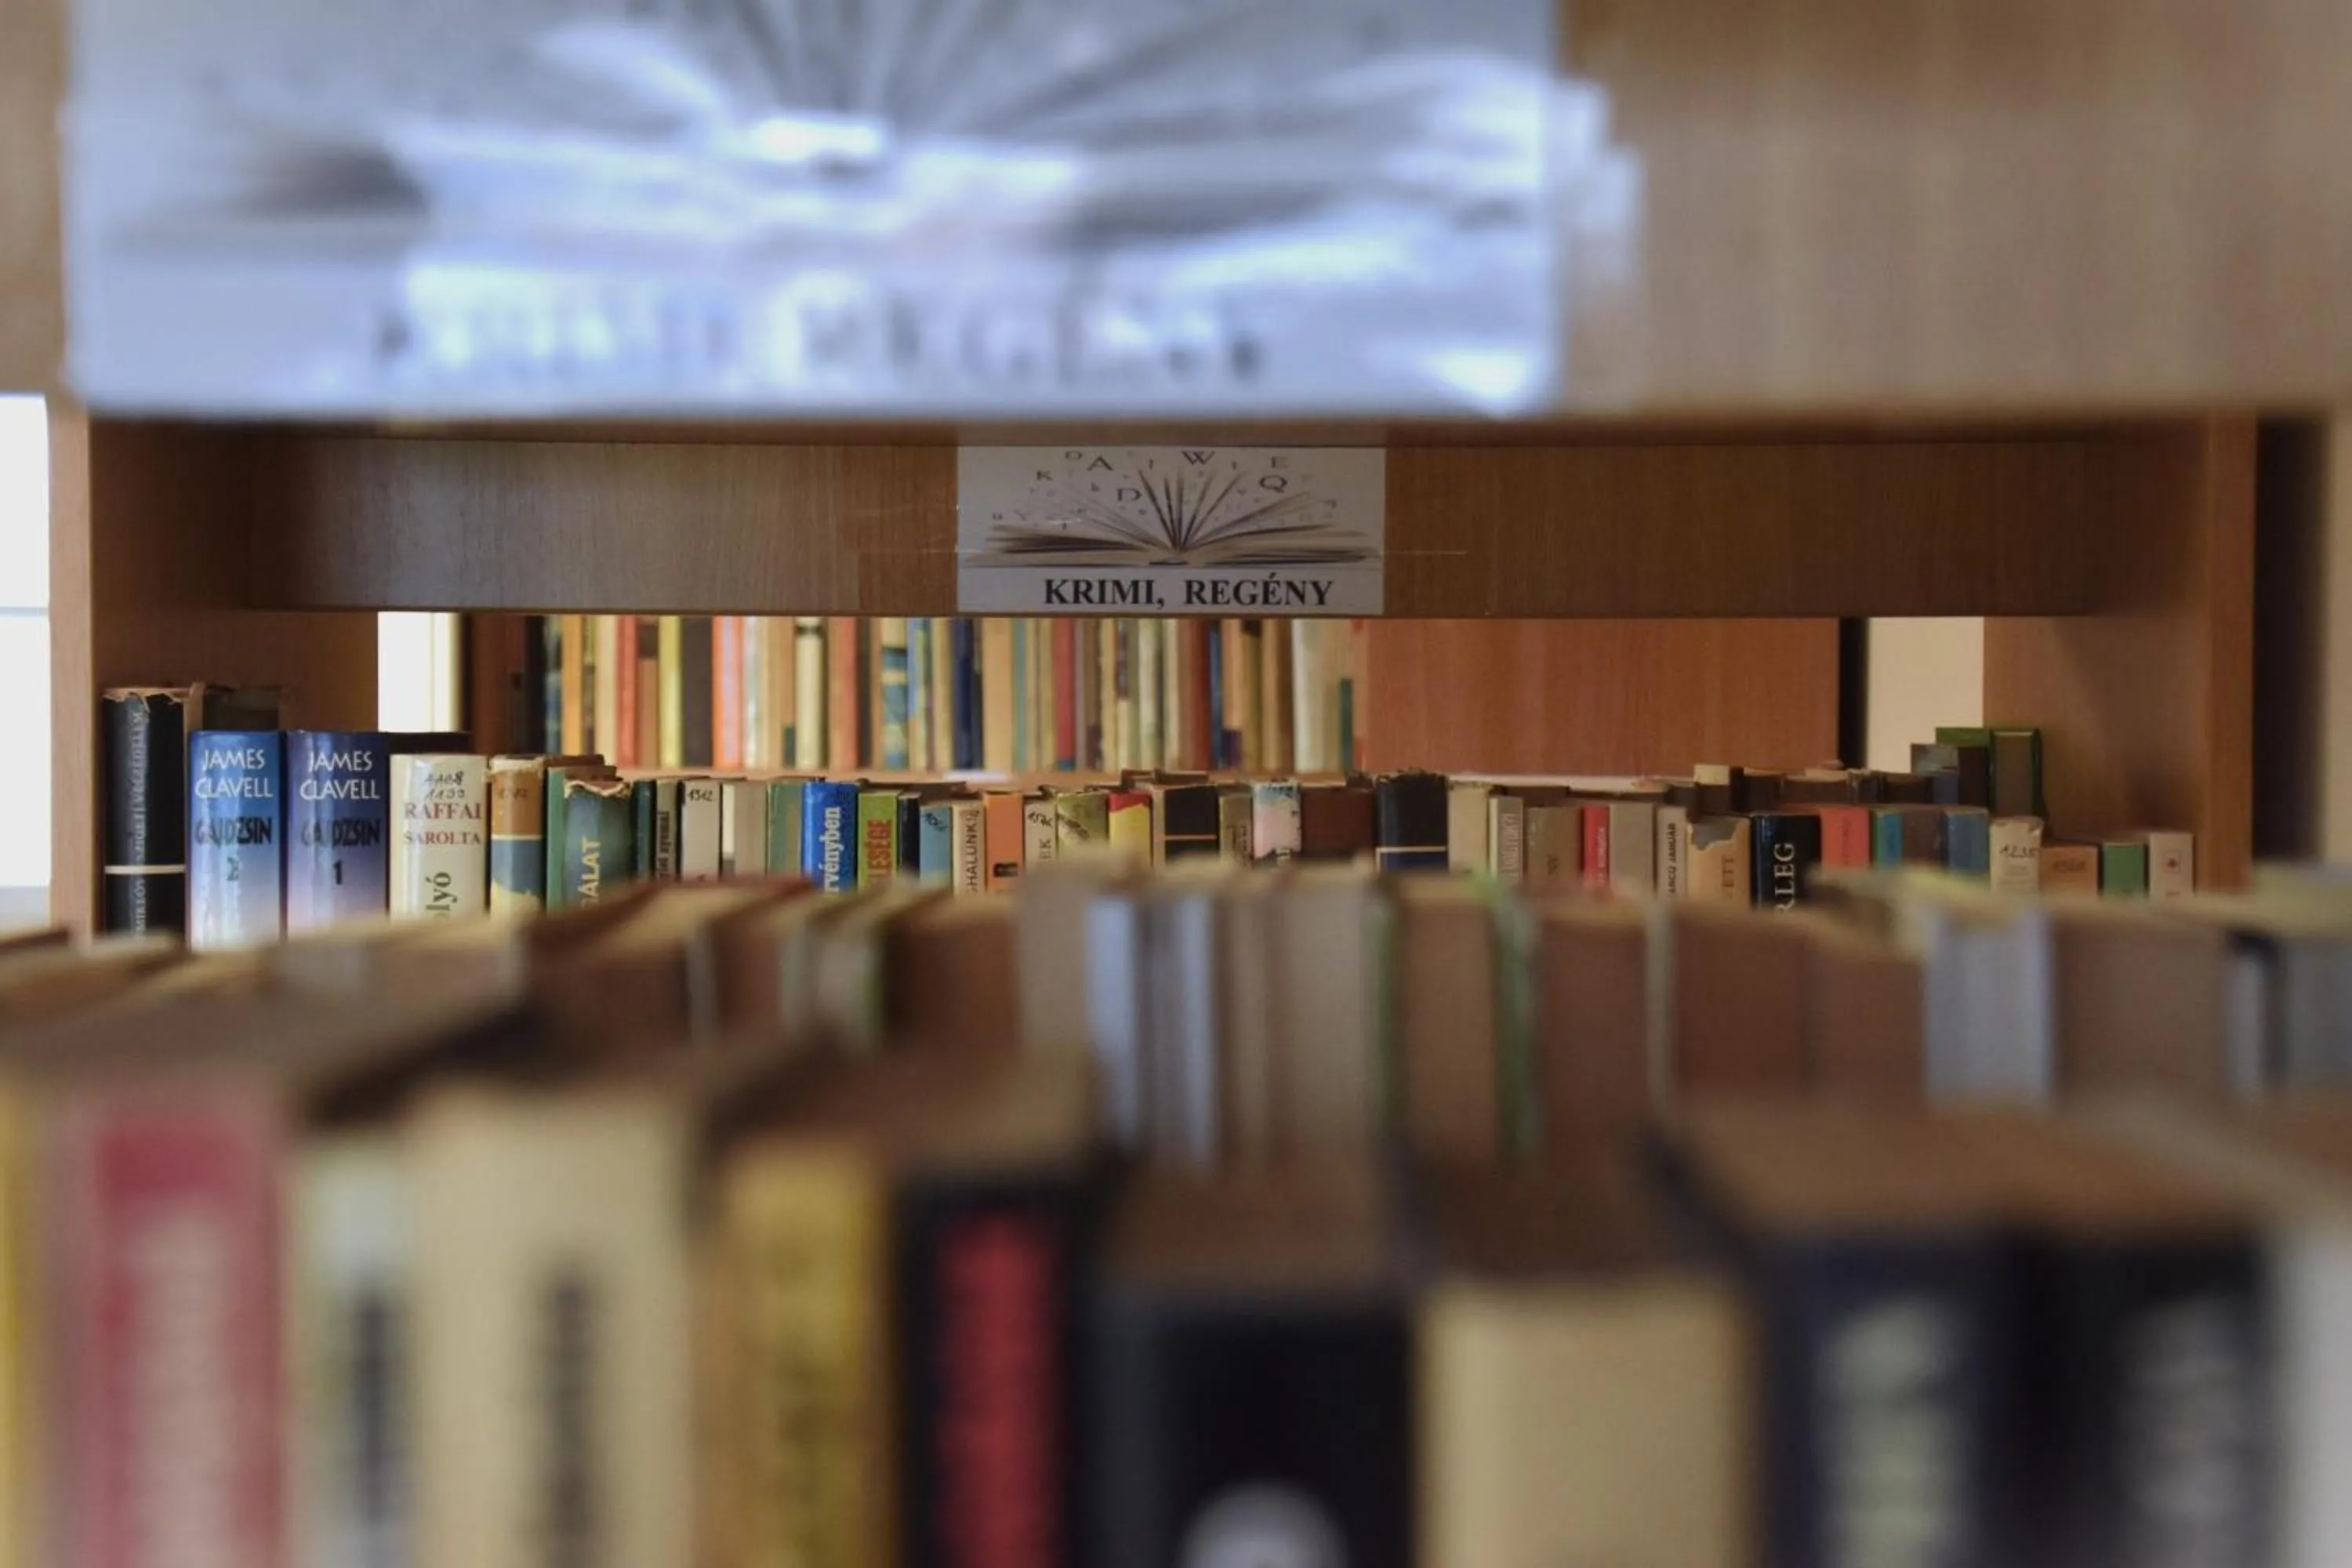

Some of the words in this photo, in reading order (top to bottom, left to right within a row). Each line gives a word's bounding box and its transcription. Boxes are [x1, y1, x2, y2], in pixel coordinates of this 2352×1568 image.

[1087, 456, 1114, 471] A
[1044, 579, 1165, 609] KRIMI,
[1184, 572, 1334, 606] REGÉNY
[201, 749, 265, 771] JAMES
[307, 750, 373, 773] JAMES
[194, 777, 274, 799] CLAVELL
[299, 779, 381, 800] CLAVELL
[404, 801, 481, 820] RAFFAI
[403, 830, 481, 845] SAROLTA
[817, 807, 844, 898] rvényben
[333, 859, 343, 886] 1
